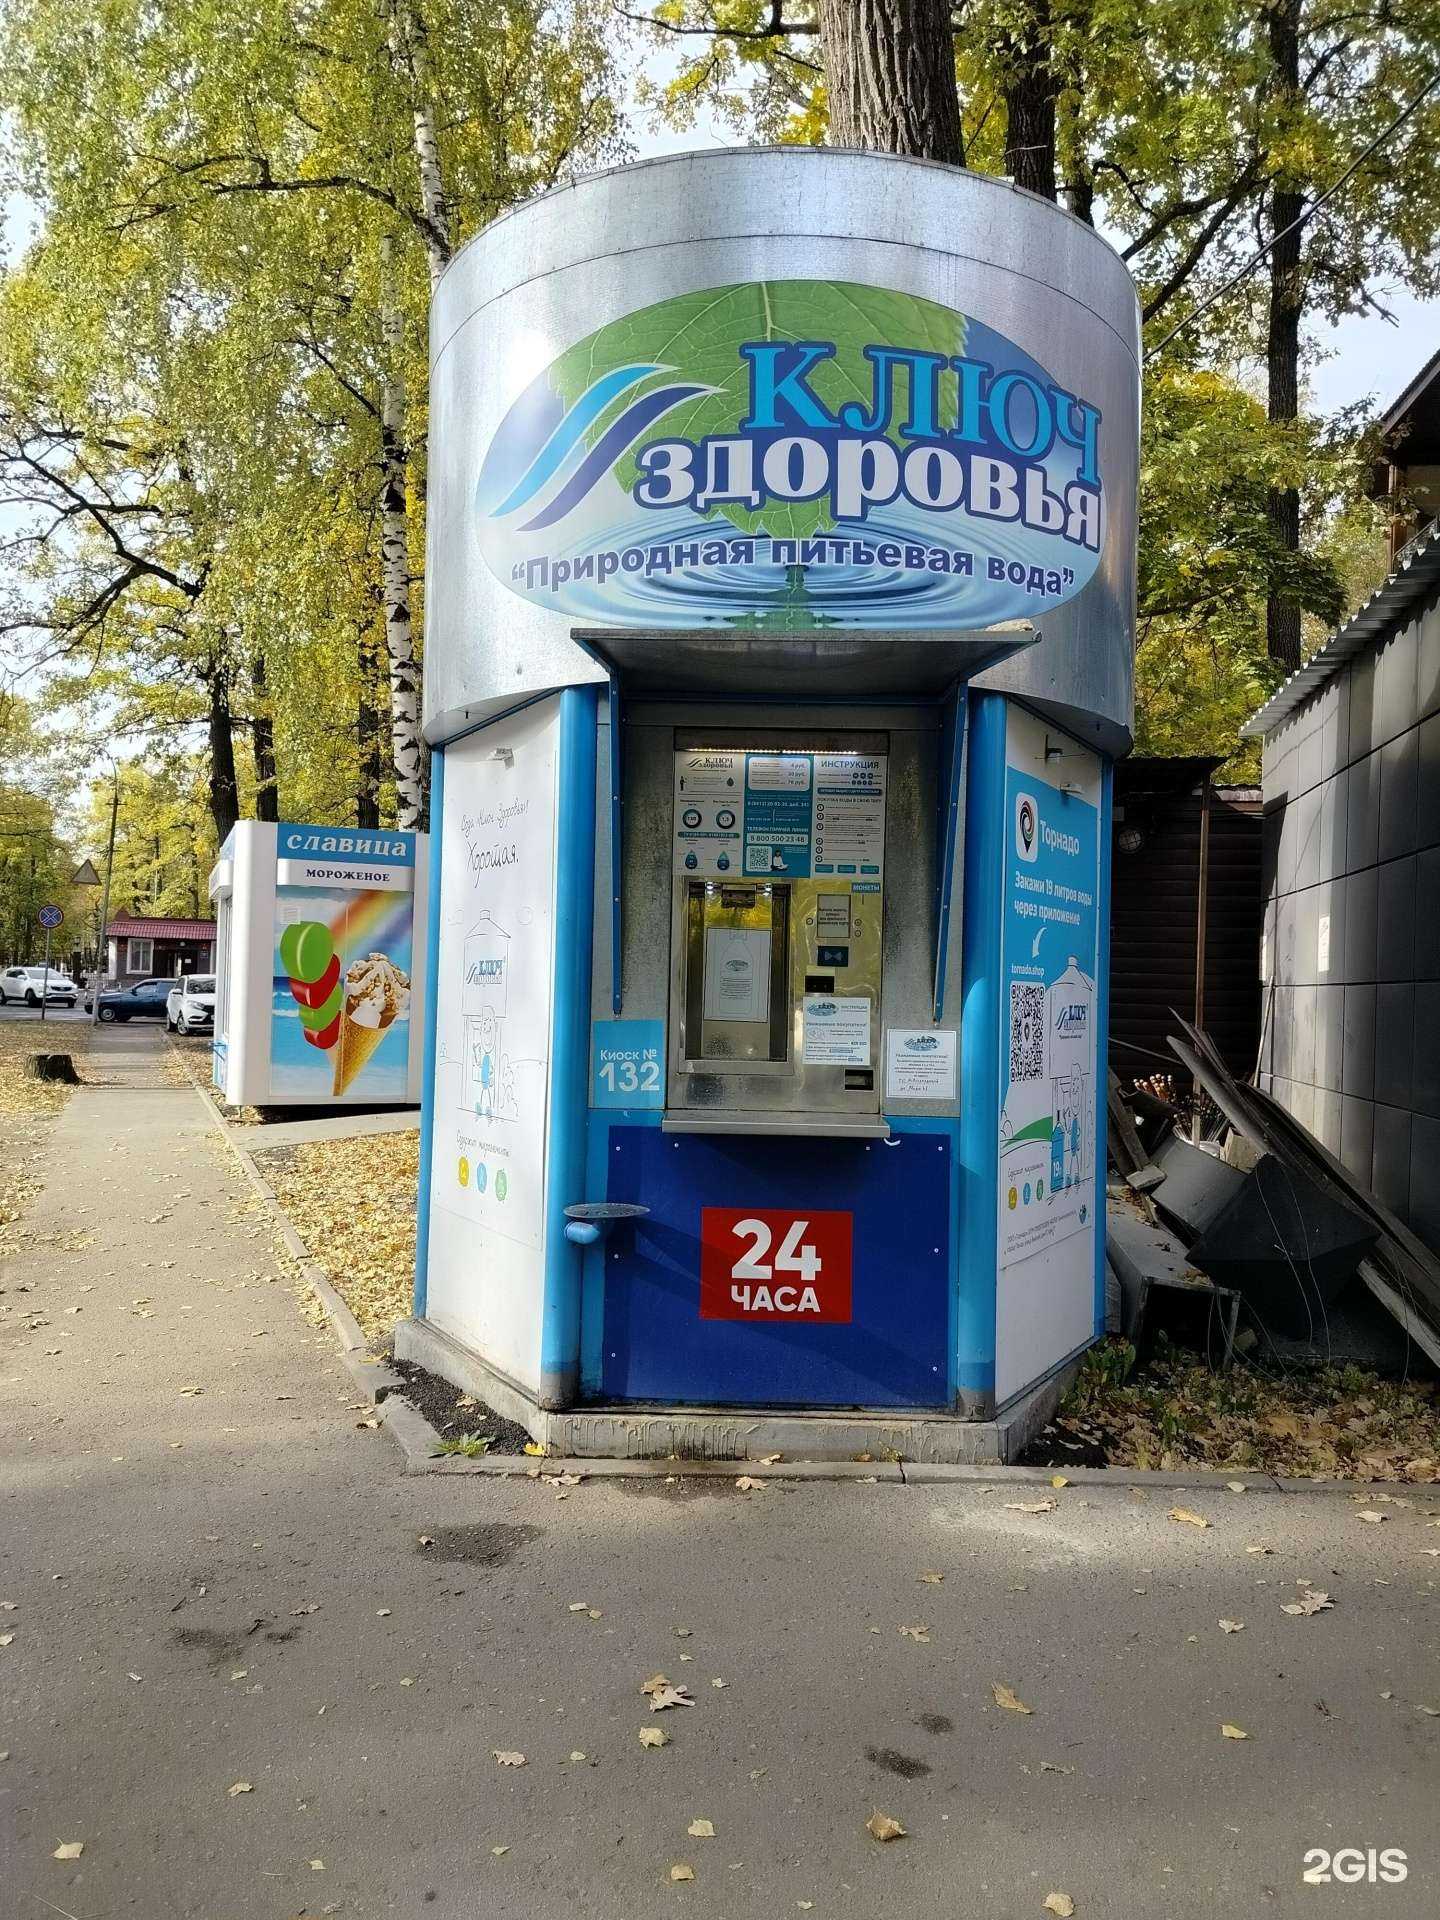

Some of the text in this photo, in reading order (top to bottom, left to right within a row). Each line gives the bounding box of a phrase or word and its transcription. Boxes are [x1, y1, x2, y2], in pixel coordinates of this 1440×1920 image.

[741, 342, 1101, 486] КЛЮЧ
[636, 434, 1101, 552] здоровья
[771, 537, 975, 578] питьевая
[821, 760, 880, 770] ИНСТРУКЦИЯ
[286, 833, 407, 858] славица
[1040, 820, 1080, 857] Торнадо
[306, 868, 391, 882] МОРОЖЕНОЕ
[853, 883, 880, 891] МОНЕТЫ
[1015, 871, 1093, 906] Закажи 19 литров воды
[1014, 900, 1080, 925] через приложение
[1011, 963, 1044, 978] tornado.shop
[600, 1049, 658, 1061] Киоск №
[599, 1062, 660, 1092] 132
[731, 1218, 822, 1281] 24
[731, 1285, 821, 1312] ЧАСА
